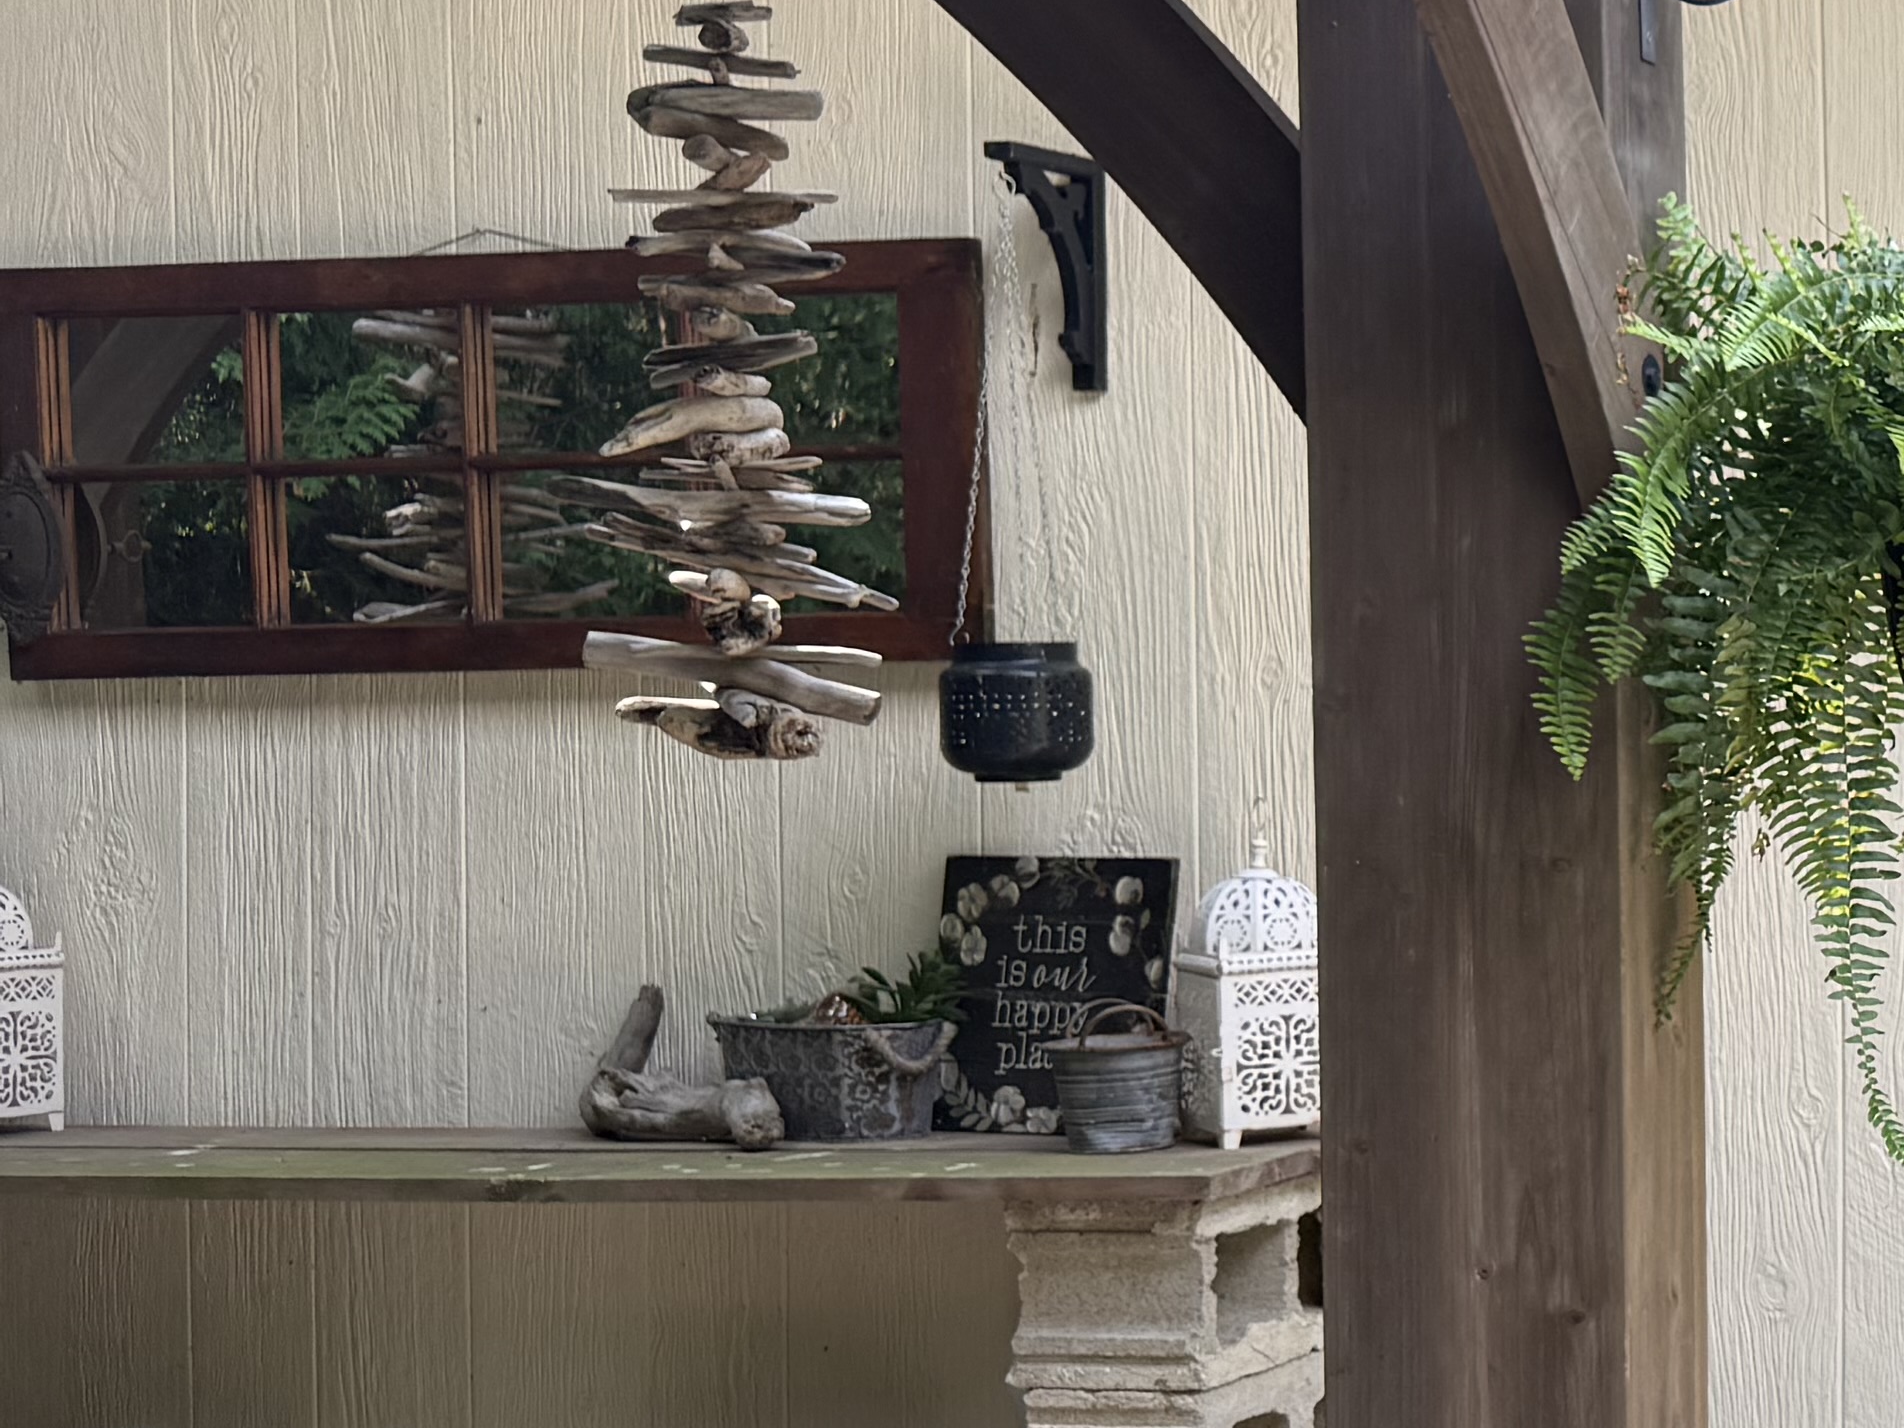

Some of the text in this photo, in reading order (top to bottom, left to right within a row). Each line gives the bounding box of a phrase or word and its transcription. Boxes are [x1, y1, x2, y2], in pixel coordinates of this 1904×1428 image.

[1013, 914, 1087, 954] this
[995, 954, 1097, 992] is our
[991, 990, 1088, 1035] happy
